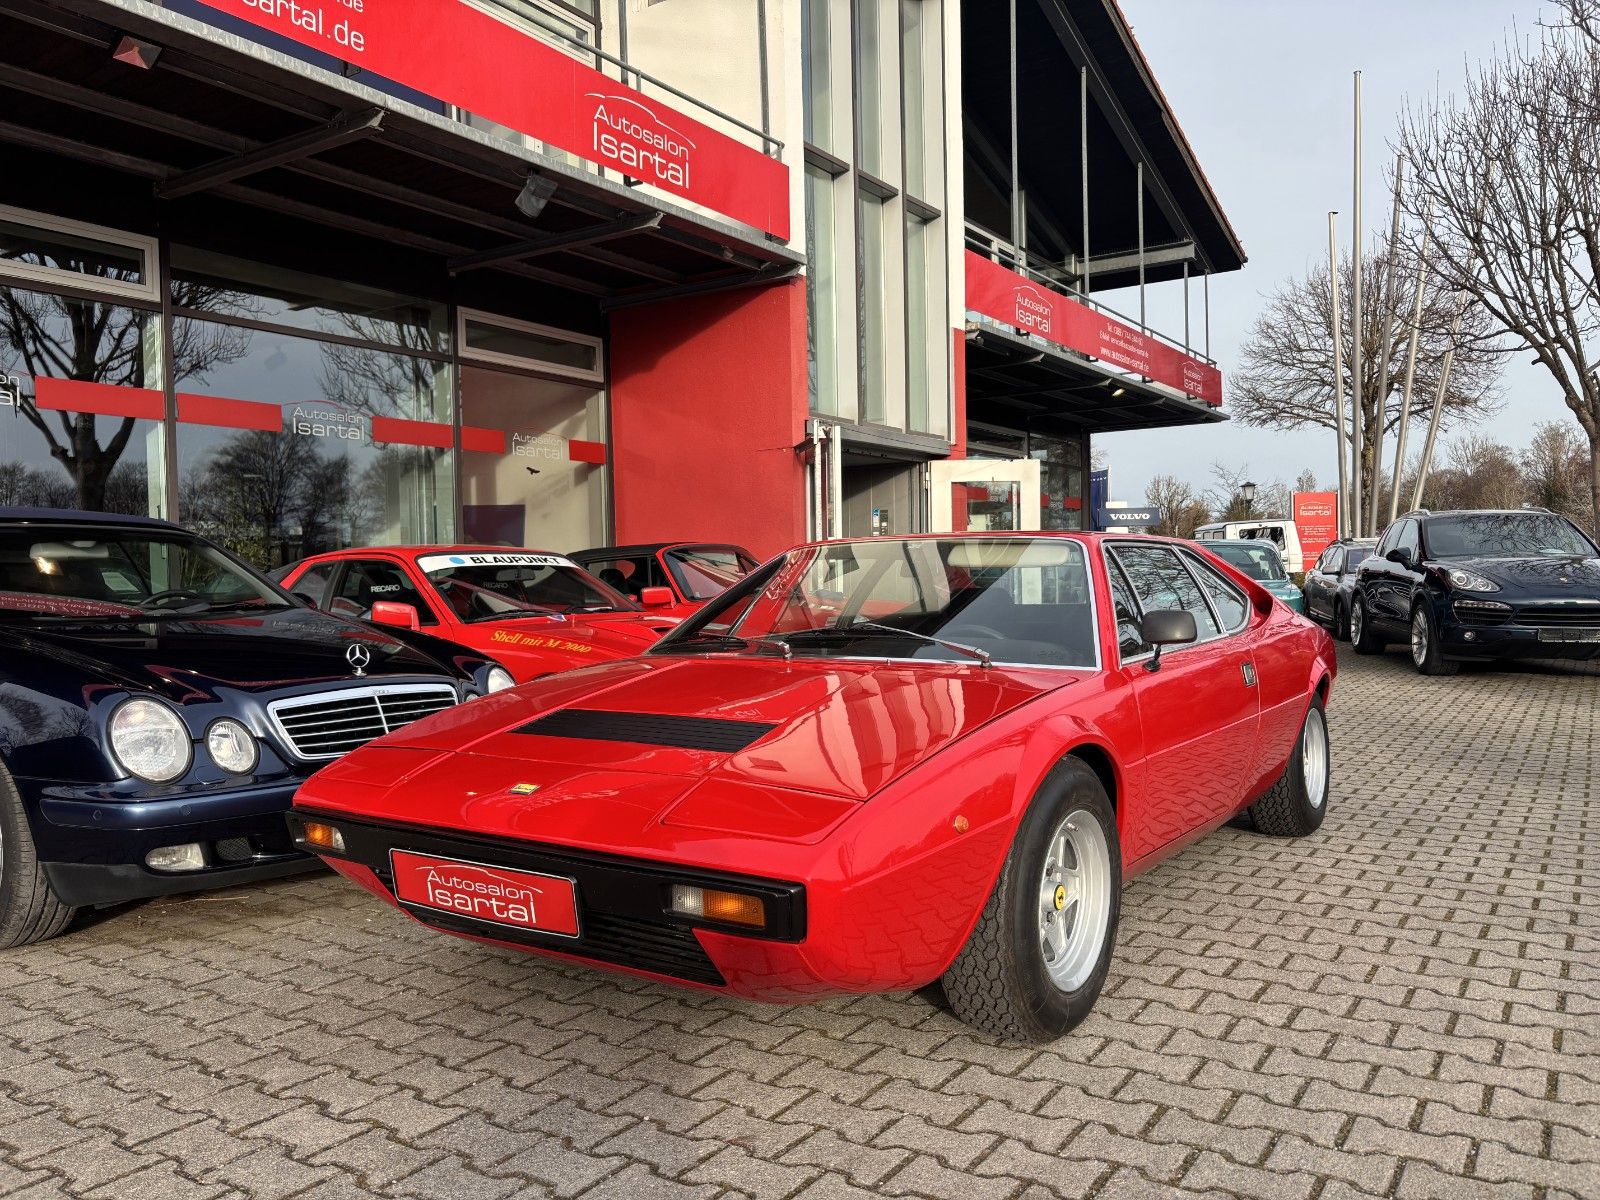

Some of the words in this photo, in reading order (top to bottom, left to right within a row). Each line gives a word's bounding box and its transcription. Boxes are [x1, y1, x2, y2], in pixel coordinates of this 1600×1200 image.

[594, 104, 689, 161] Autosalon
[593, 121, 690, 189] Isartal
[1016, 293, 1051, 317] Autosalon
[1015, 303, 1051, 334] Isartal
[293, 406, 365, 424] Autosalon
[292, 417, 365, 441] Isartal
[512, 432, 563, 447] Autosalon
[512, 441, 563, 460] Isartal
[1109, 513, 1151, 521] VOLVO
[469, 556, 561, 565] BLAUPUNKT
[370, 583, 400, 593] RECARO
[491, 630, 523, 644] Shell
[521, 636, 544, 647] mit
[542, 638, 562, 648] M
[559, 642, 593, 653] 2000
[427, 869, 534, 902] Autosalon
[427, 881, 537, 924] Isartal
